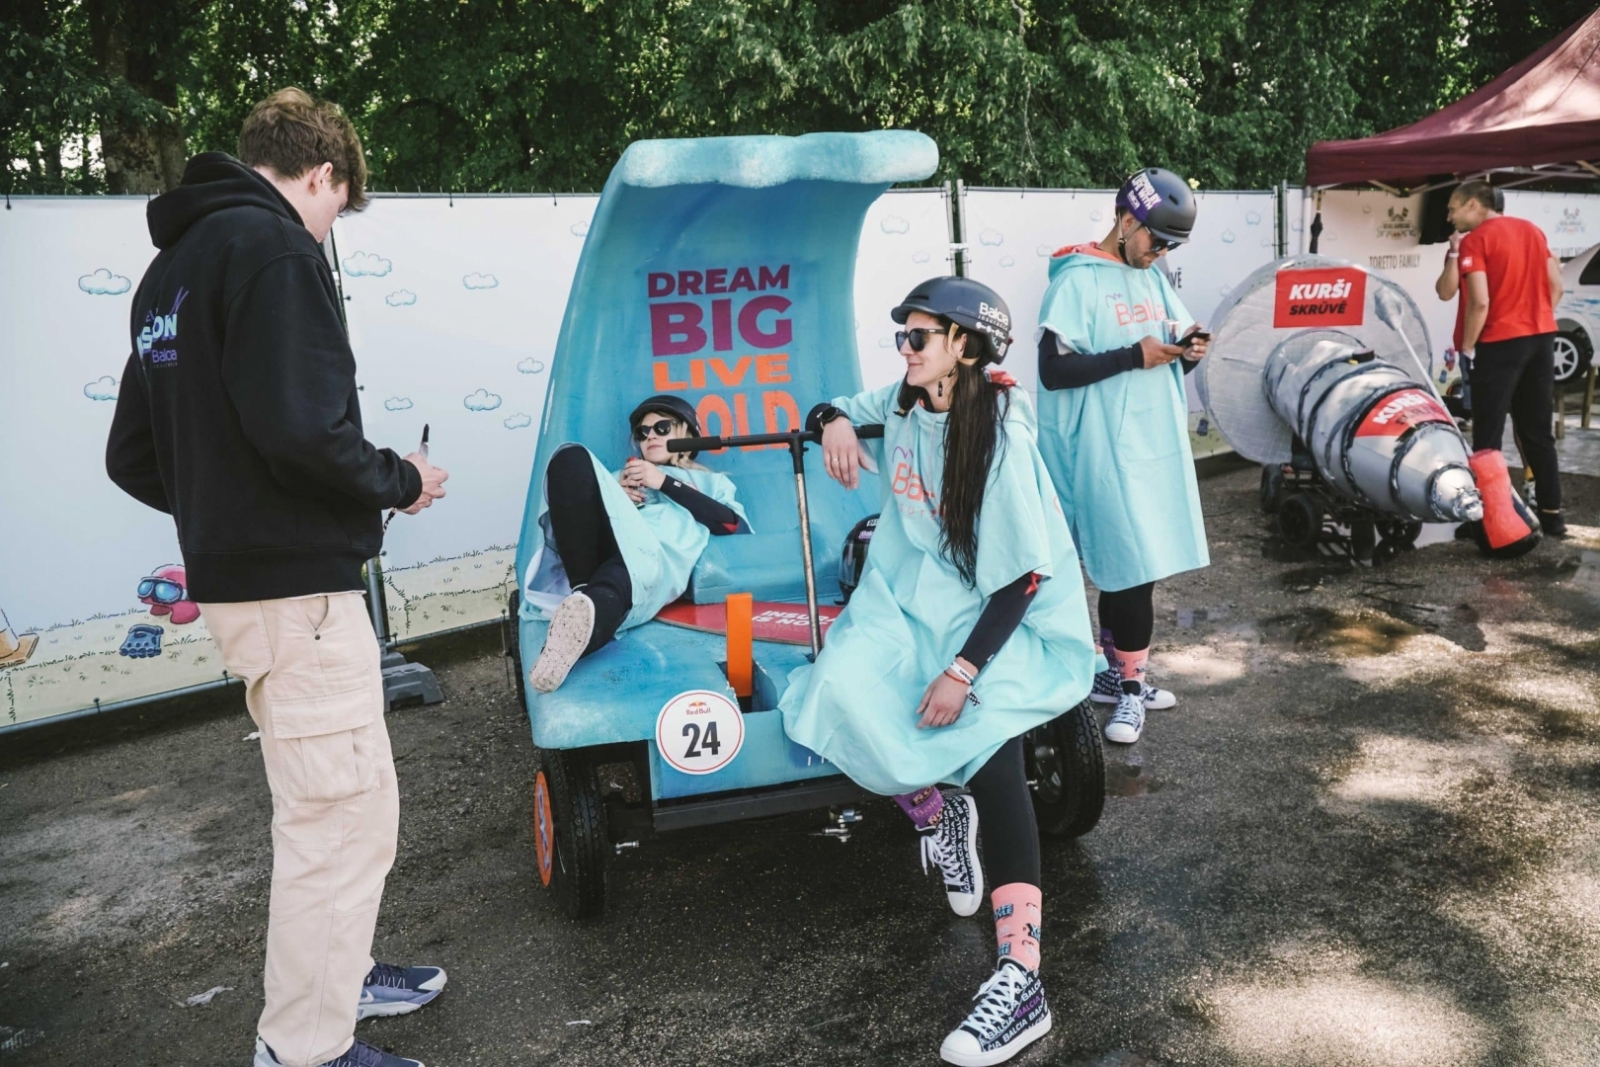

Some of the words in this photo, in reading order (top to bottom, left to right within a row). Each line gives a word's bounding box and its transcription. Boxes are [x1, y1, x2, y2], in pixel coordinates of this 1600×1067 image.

[1369, 255, 1397, 270] TORETTO
[1399, 253, 1421, 268] FAMILY
[648, 264, 790, 298] DREAM
[1289, 278, 1352, 300] KURŠI
[1289, 300, 1347, 316] SKRŪVĒ
[649, 294, 793, 357] BIG
[151, 348, 178, 363] Balcia
[653, 353, 791, 392] LIVE
[696, 390, 801, 455] OLD
[752, 615, 774, 623] IS
[686, 708, 698, 716] Red
[699, 706, 711, 715] Bull
[682, 721, 721, 759] 24
[1016, 995, 1041, 1019] BALCIA
[987, 1015, 1015, 1040] BALCIA
[1002, 1018, 1028, 1043] BALCIA
